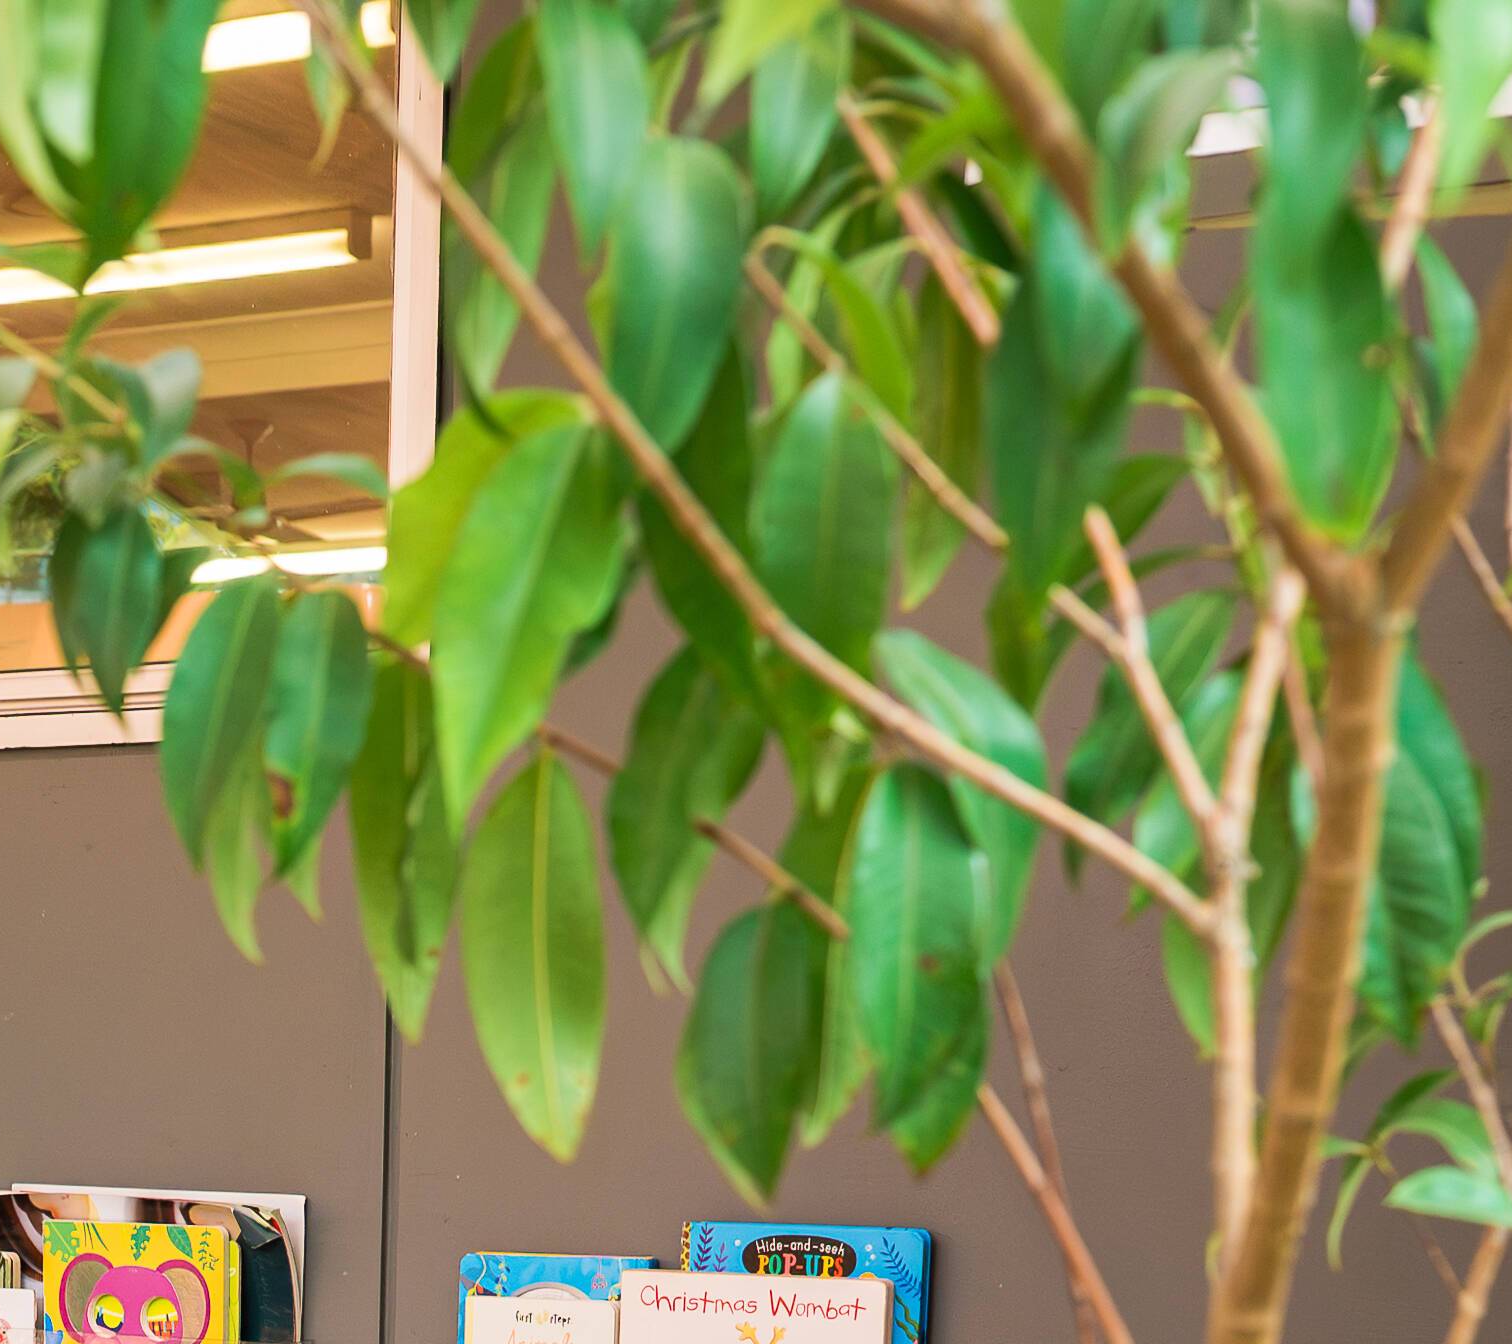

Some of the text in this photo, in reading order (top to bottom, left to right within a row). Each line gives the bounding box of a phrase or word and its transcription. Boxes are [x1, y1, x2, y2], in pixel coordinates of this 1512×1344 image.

[755, 1238, 845, 1257] Hide-and-seek
[756, 1253, 844, 1277] POP-UPS
[640, 1284, 867, 1321] Christmas Wombat
[515, 1310, 571, 1327] first steps
